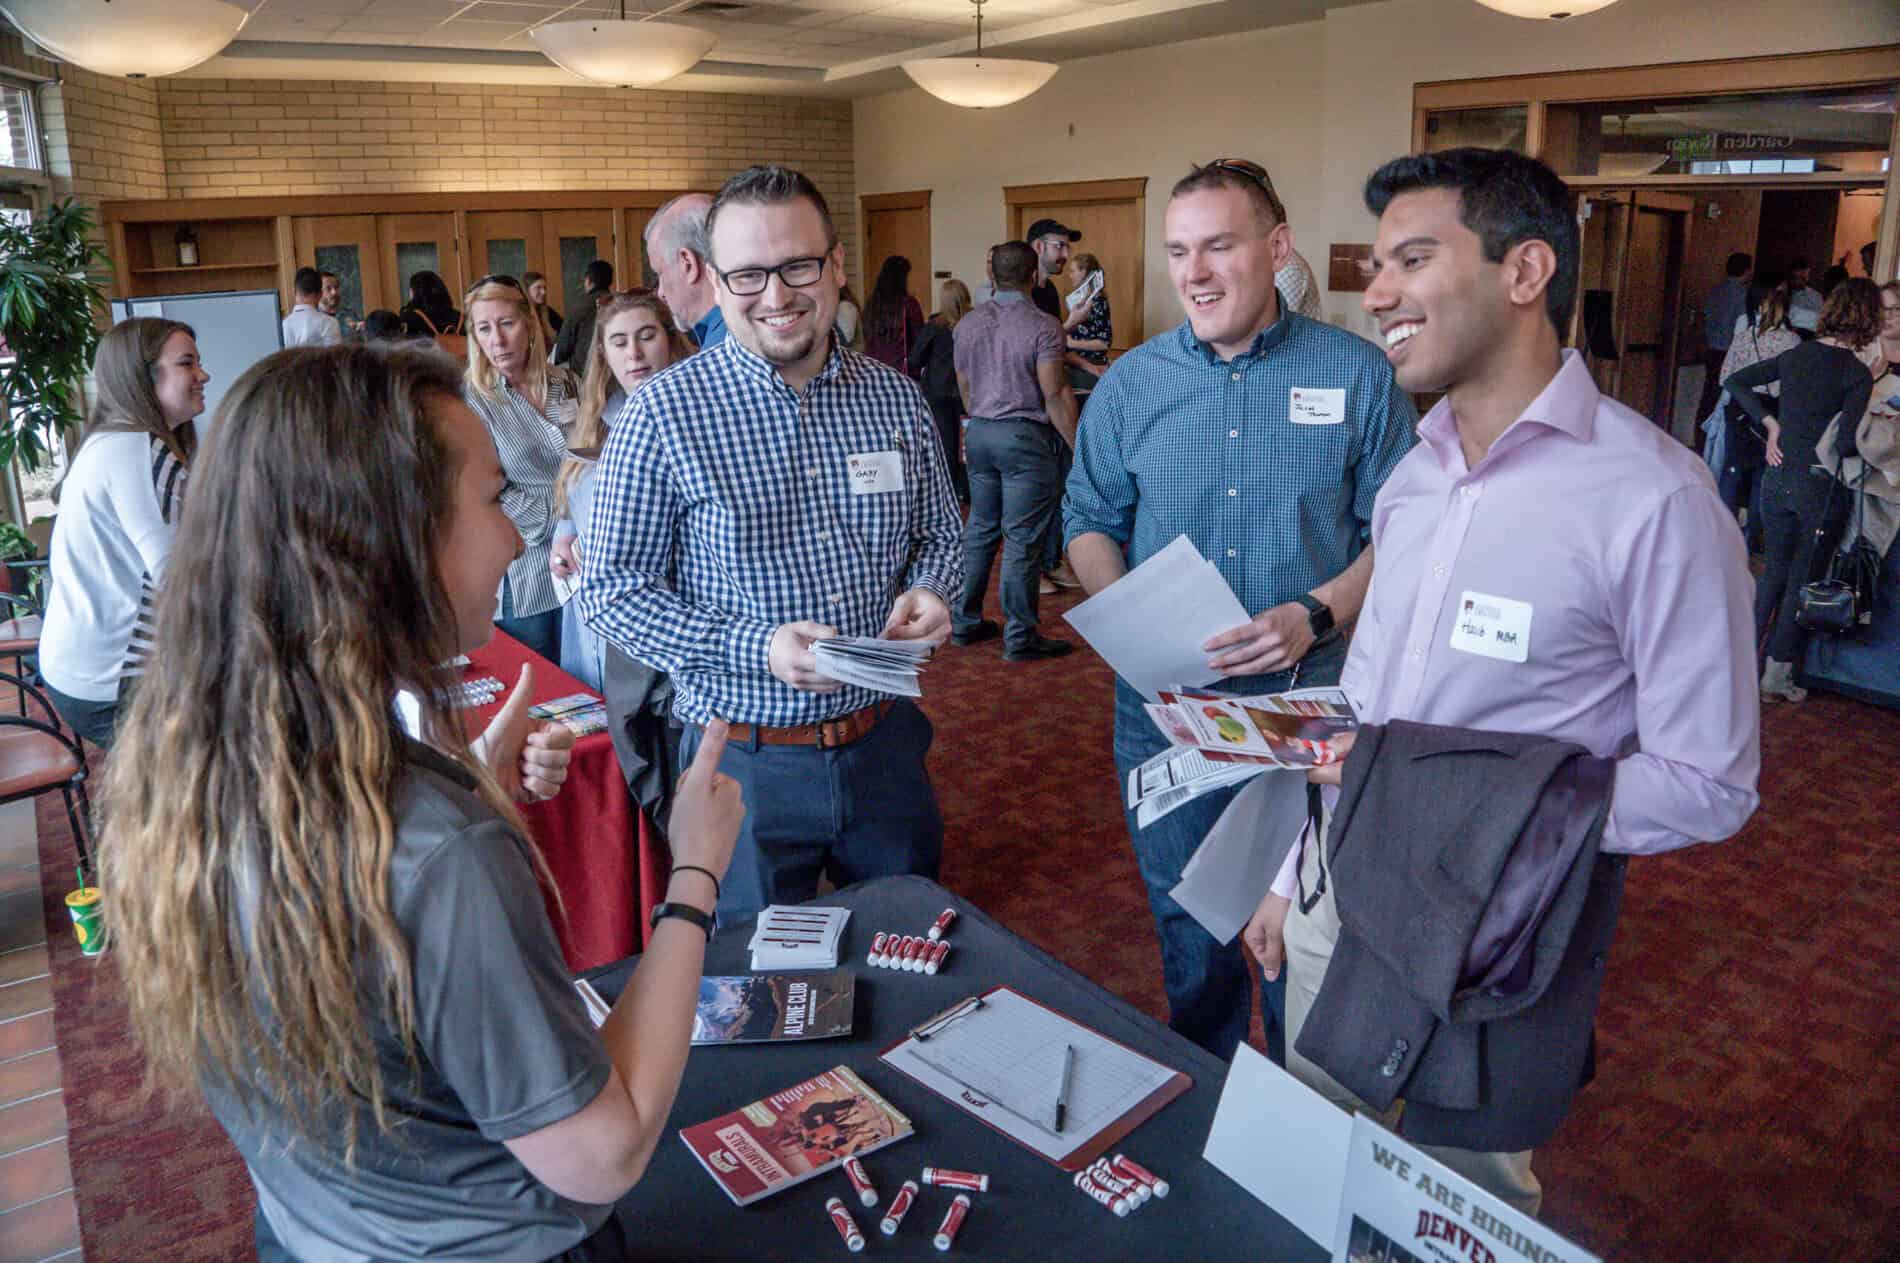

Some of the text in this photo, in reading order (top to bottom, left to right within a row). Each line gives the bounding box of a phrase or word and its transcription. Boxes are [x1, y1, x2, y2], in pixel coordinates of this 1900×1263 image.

[783, 982, 808, 1035] ALPINE CLUB
[725, 1131, 779, 1184] INTRAMURALS
[1371, 1140, 1411, 1182] WE
[1415, 1172, 1466, 1217] ARE
